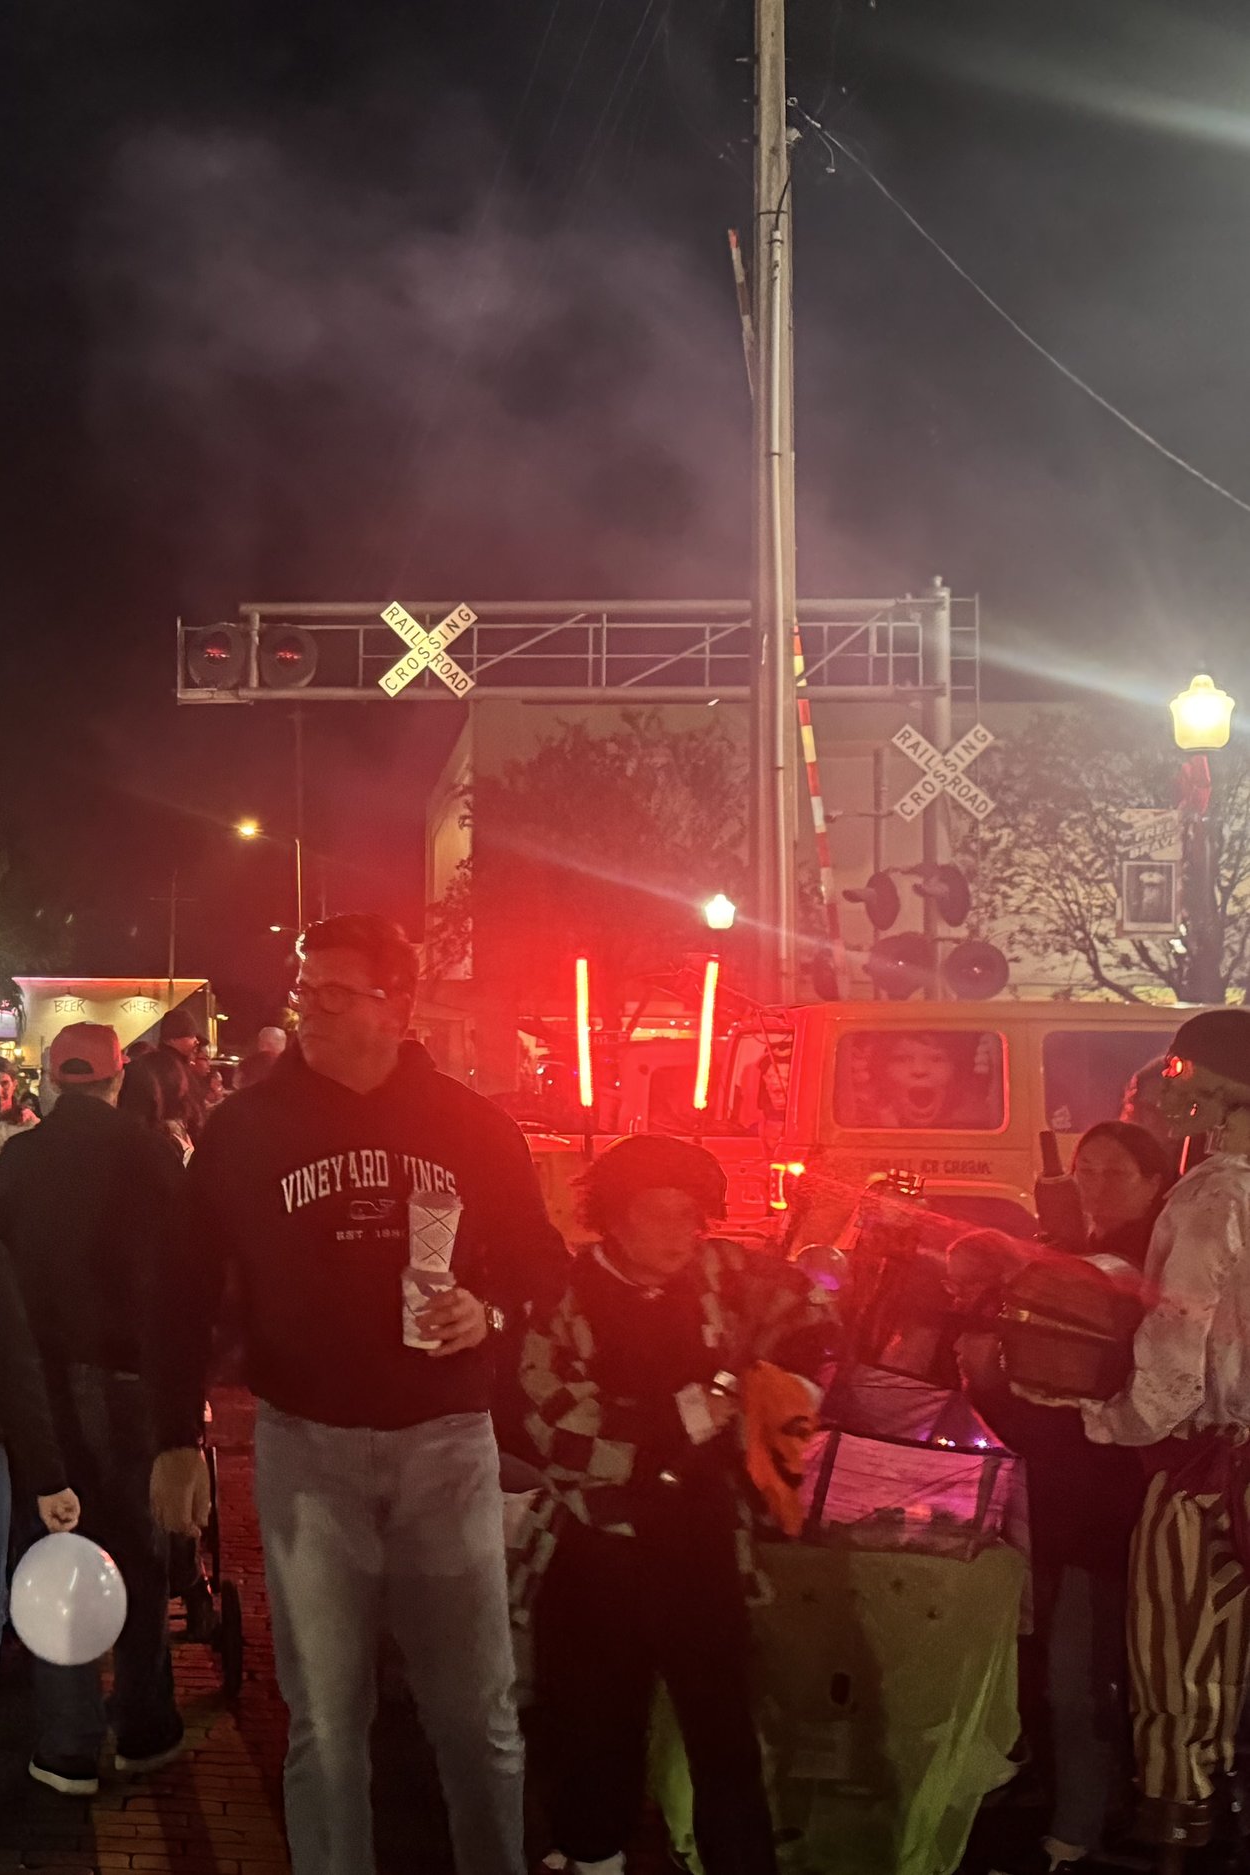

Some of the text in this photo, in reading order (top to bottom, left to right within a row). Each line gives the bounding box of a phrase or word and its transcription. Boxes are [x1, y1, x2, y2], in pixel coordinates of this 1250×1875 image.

[384, 608, 472, 691] CROSSING
[385, 606, 469, 692] RAILROAD
[896, 729, 989, 814] RAILROAD
[899, 729, 989, 817] CROSSING
[53, 1000, 86, 1015] BEER
[120, 1000, 160, 1016] CHEER
[281, 1149, 390, 1214] VINEYARD
